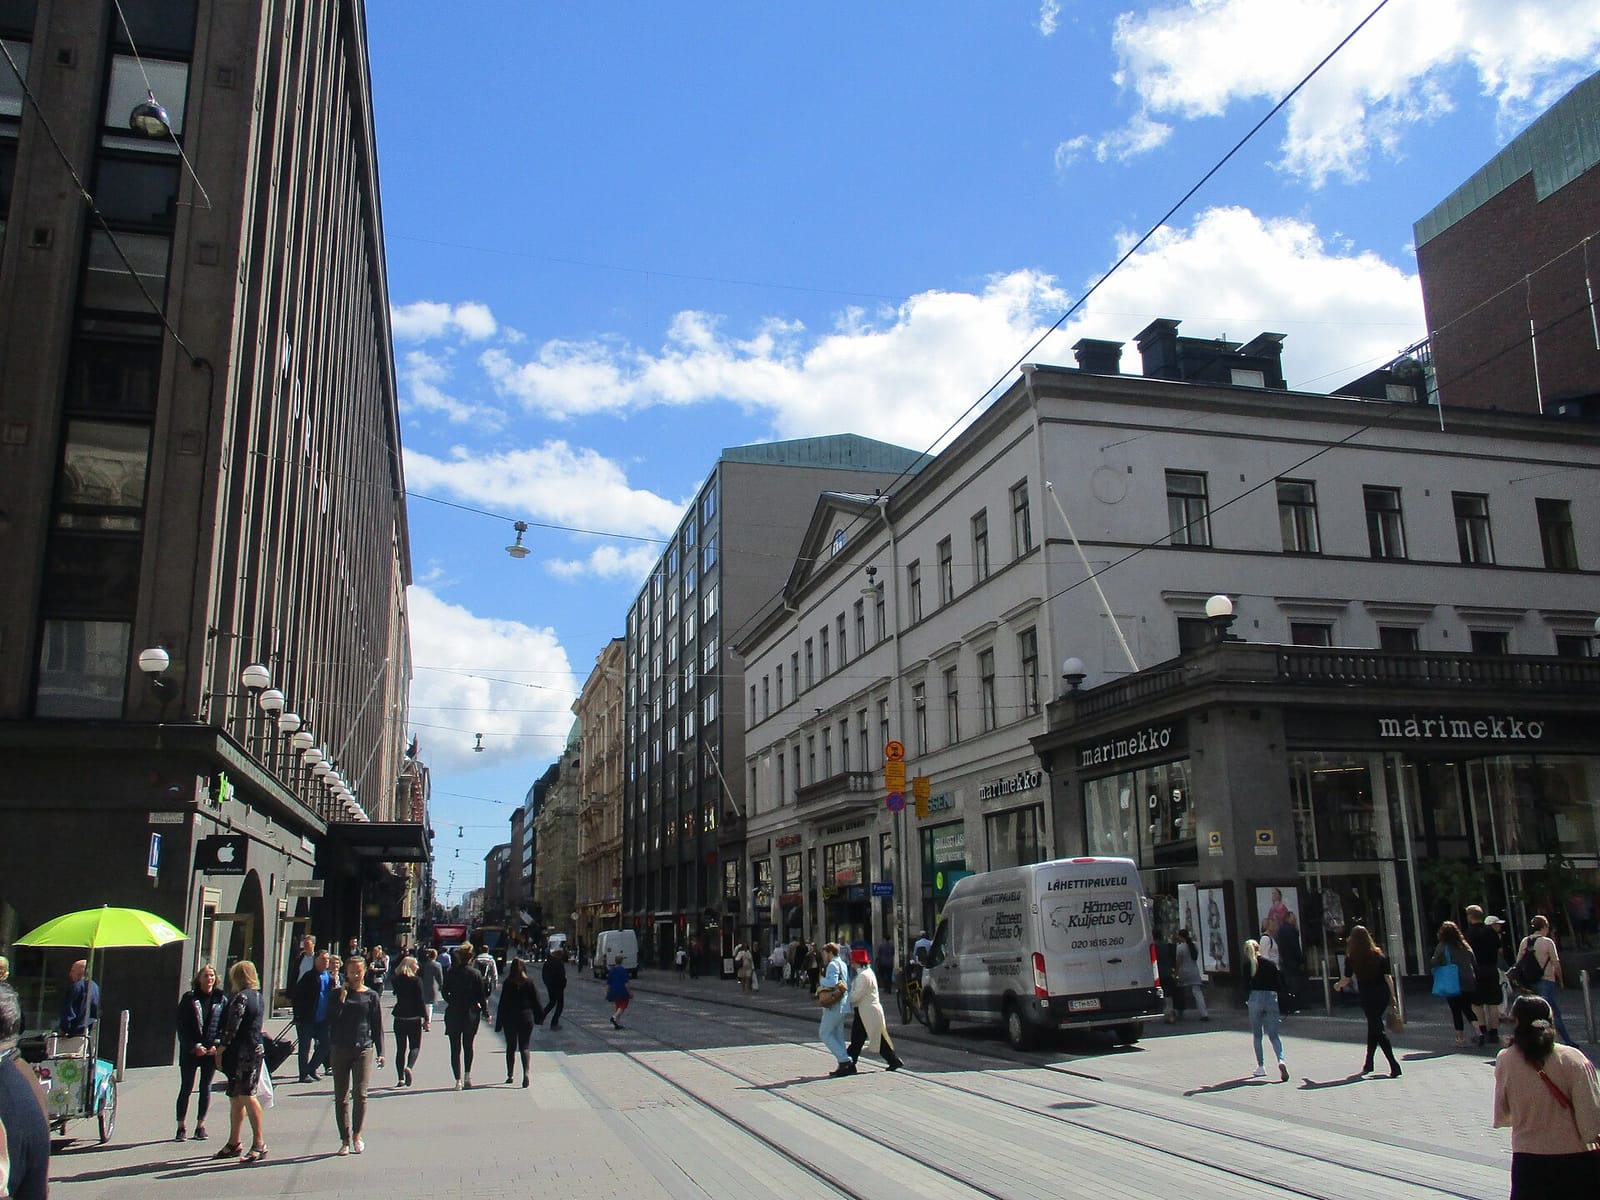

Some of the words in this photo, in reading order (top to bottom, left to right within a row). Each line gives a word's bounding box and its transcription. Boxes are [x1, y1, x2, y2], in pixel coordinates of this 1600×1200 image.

[1378, 715, 1543, 739] marimekko
[1082, 728, 1170, 766] marimekko
[978, 771, 1040, 800] marimekko
[1047, 876, 1128, 891] LÄHETTIPALVELU
[1082, 900, 1133, 914] Hämeen
[1067, 913, 1116, 928] Kuljetus
[1118, 911, 1135, 926] Oy
[1071, 939, 1088, 949] 020
[1108, 936, 1124, 946] 260
